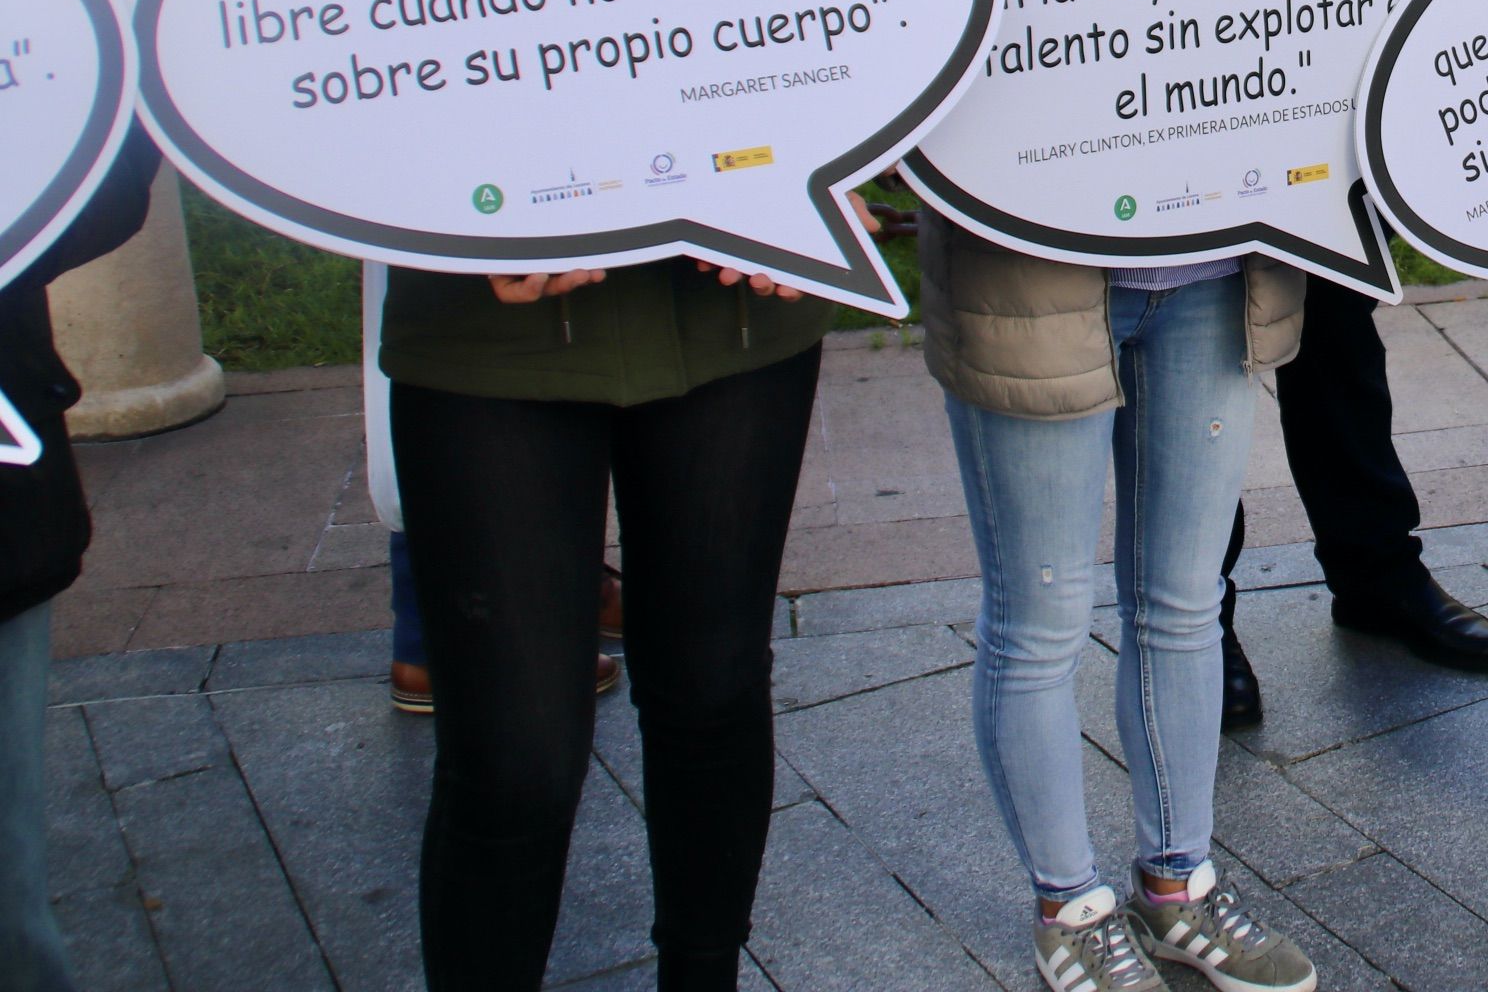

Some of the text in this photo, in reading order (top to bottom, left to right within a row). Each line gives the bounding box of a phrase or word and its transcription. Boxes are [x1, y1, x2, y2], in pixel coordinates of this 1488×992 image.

[293, 54, 446, 108] sobre
[465, 48, 520, 85] su
[538, 18, 693, 90] propio
[1145, 10, 1200, 54] sin
[680, 65, 851, 103] MARGARET SANGER
[1116, 50, 1311, 119] el mundo."
[1018, 142, 1077, 165] HILLARY
[1080, 132, 1145, 154] CLINTON,
[1148, 128, 1165, 144] EX
[1168, 118, 1228, 141] PRIMERA
[1229, 112, 1270, 130] DAMA
[1273, 107, 1290, 123] DE
[1292, 98, 1350, 120] ESTADOS
